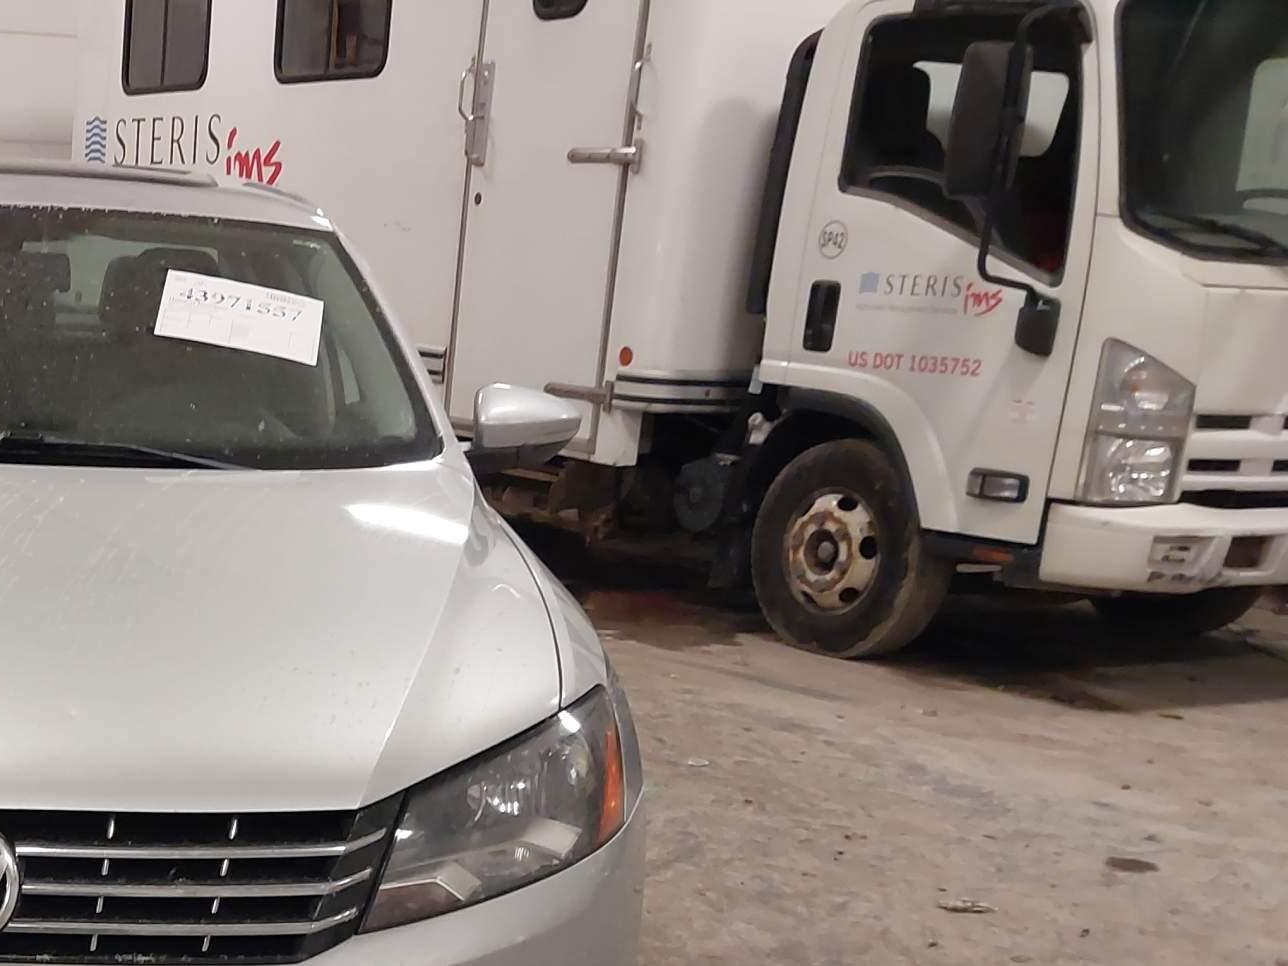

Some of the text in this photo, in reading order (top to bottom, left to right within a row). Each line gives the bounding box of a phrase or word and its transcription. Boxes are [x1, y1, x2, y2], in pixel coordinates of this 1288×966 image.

[113, 114, 221, 167] STERIS
[883, 273, 964, 298] STERIS
[847, 351, 982, 377] US DOT 1035752
